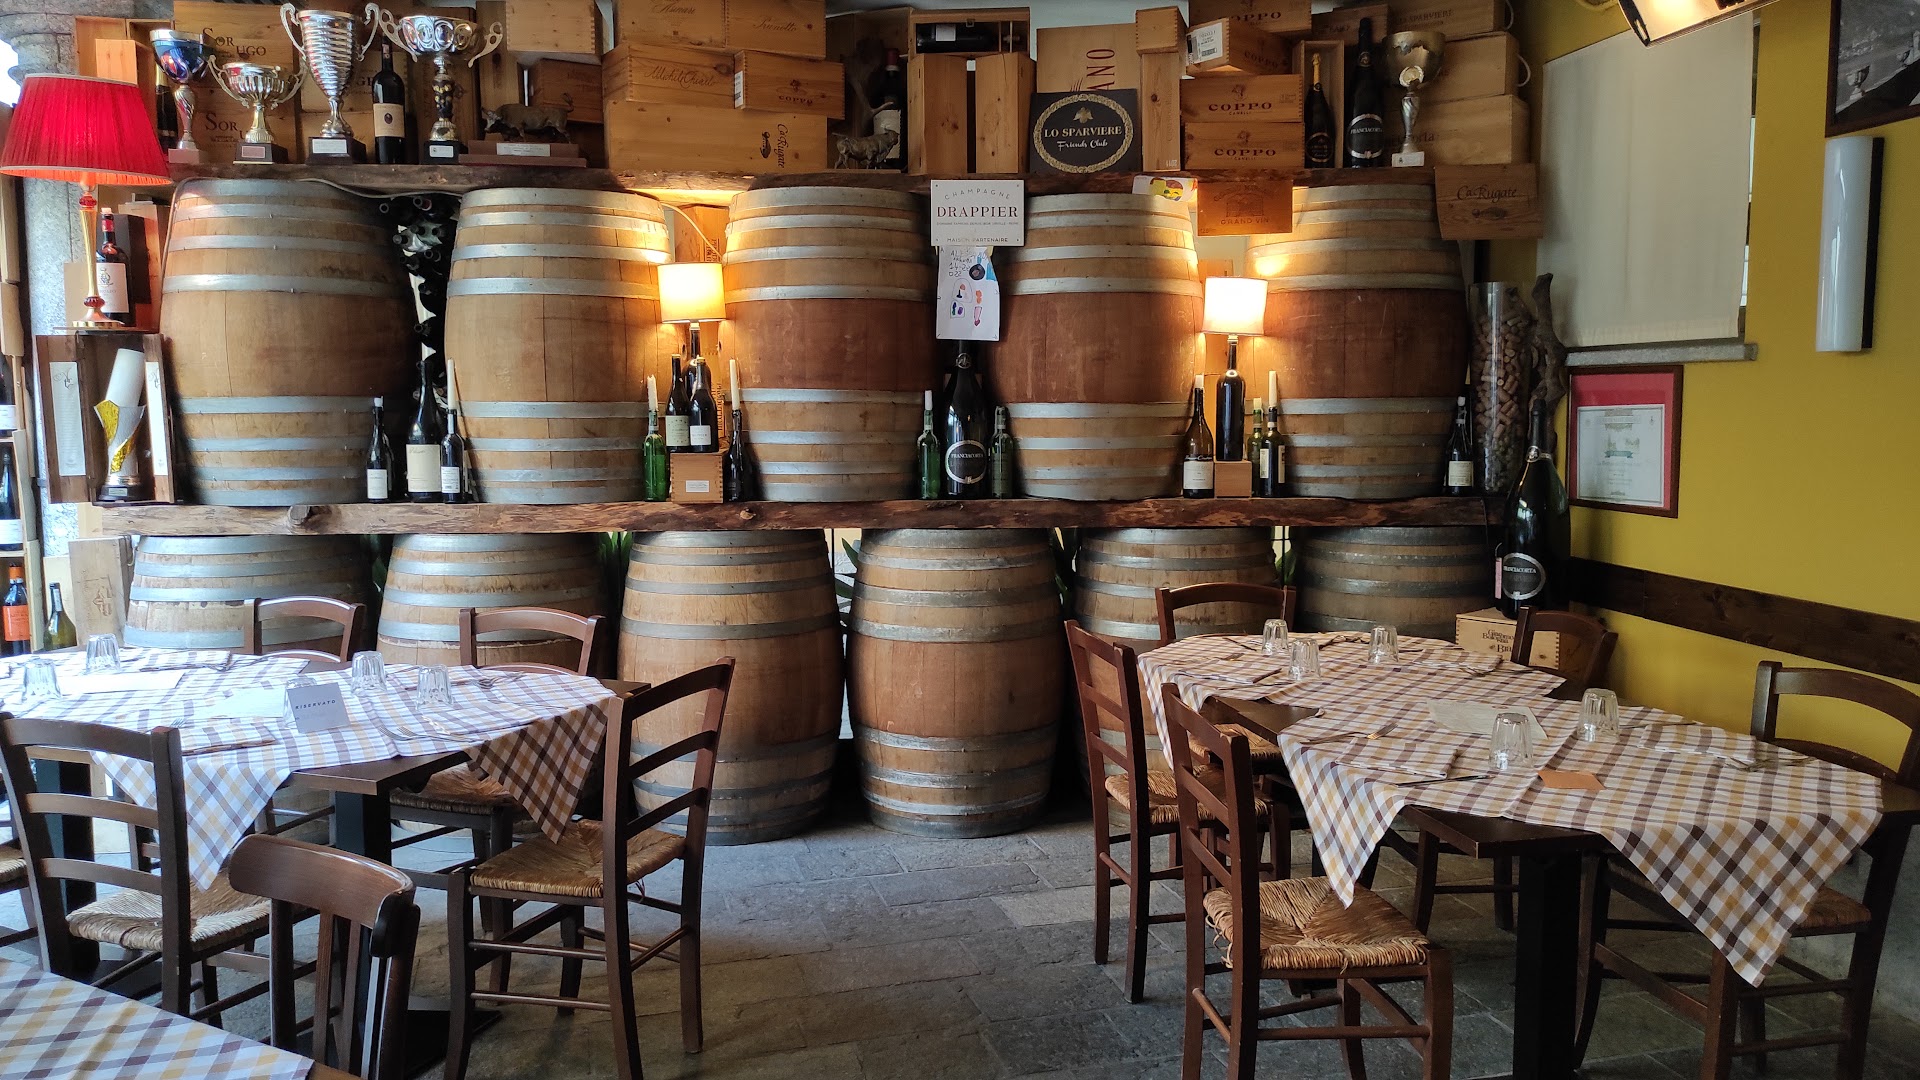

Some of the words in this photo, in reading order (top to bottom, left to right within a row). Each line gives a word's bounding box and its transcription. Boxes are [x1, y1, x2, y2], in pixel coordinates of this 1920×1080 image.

[1208, 102, 1272, 112] COPPO
[1044, 129, 1059, 138] LO
[1062, 126, 1122, 137] SPARVIERE
[1056, 140, 1088, 151] Friends
[1090, 139, 1108, 148] Club
[1214, 148, 1277, 157] COPPO
[944, 188, 1010, 200] CHAMPAGNE
[937, 206, 1018, 218] DRAPPIER
[1220, 217, 1253, 225] GRAND
[295, 699, 336, 710] RISERVATO
